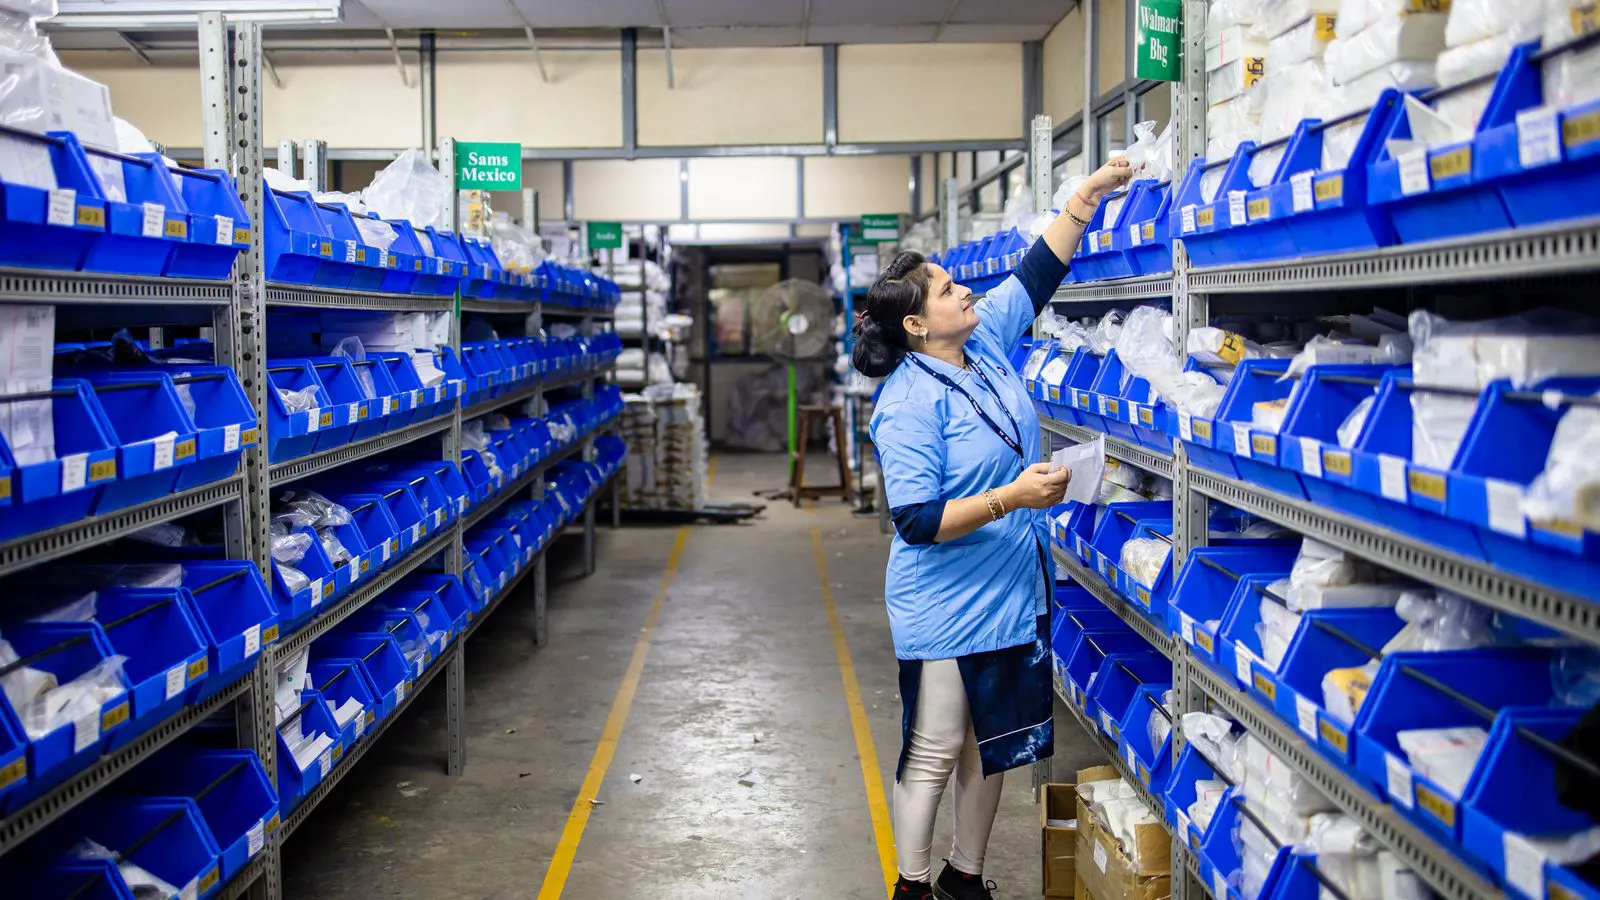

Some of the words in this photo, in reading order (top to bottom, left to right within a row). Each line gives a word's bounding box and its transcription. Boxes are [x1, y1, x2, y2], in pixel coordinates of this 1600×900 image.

[1140, 5, 1179, 34] Walmart
[1150, 37, 1168, 68] Bhg
[468, 151, 509, 166] Sams
[461, 167, 516, 182] Mexico
